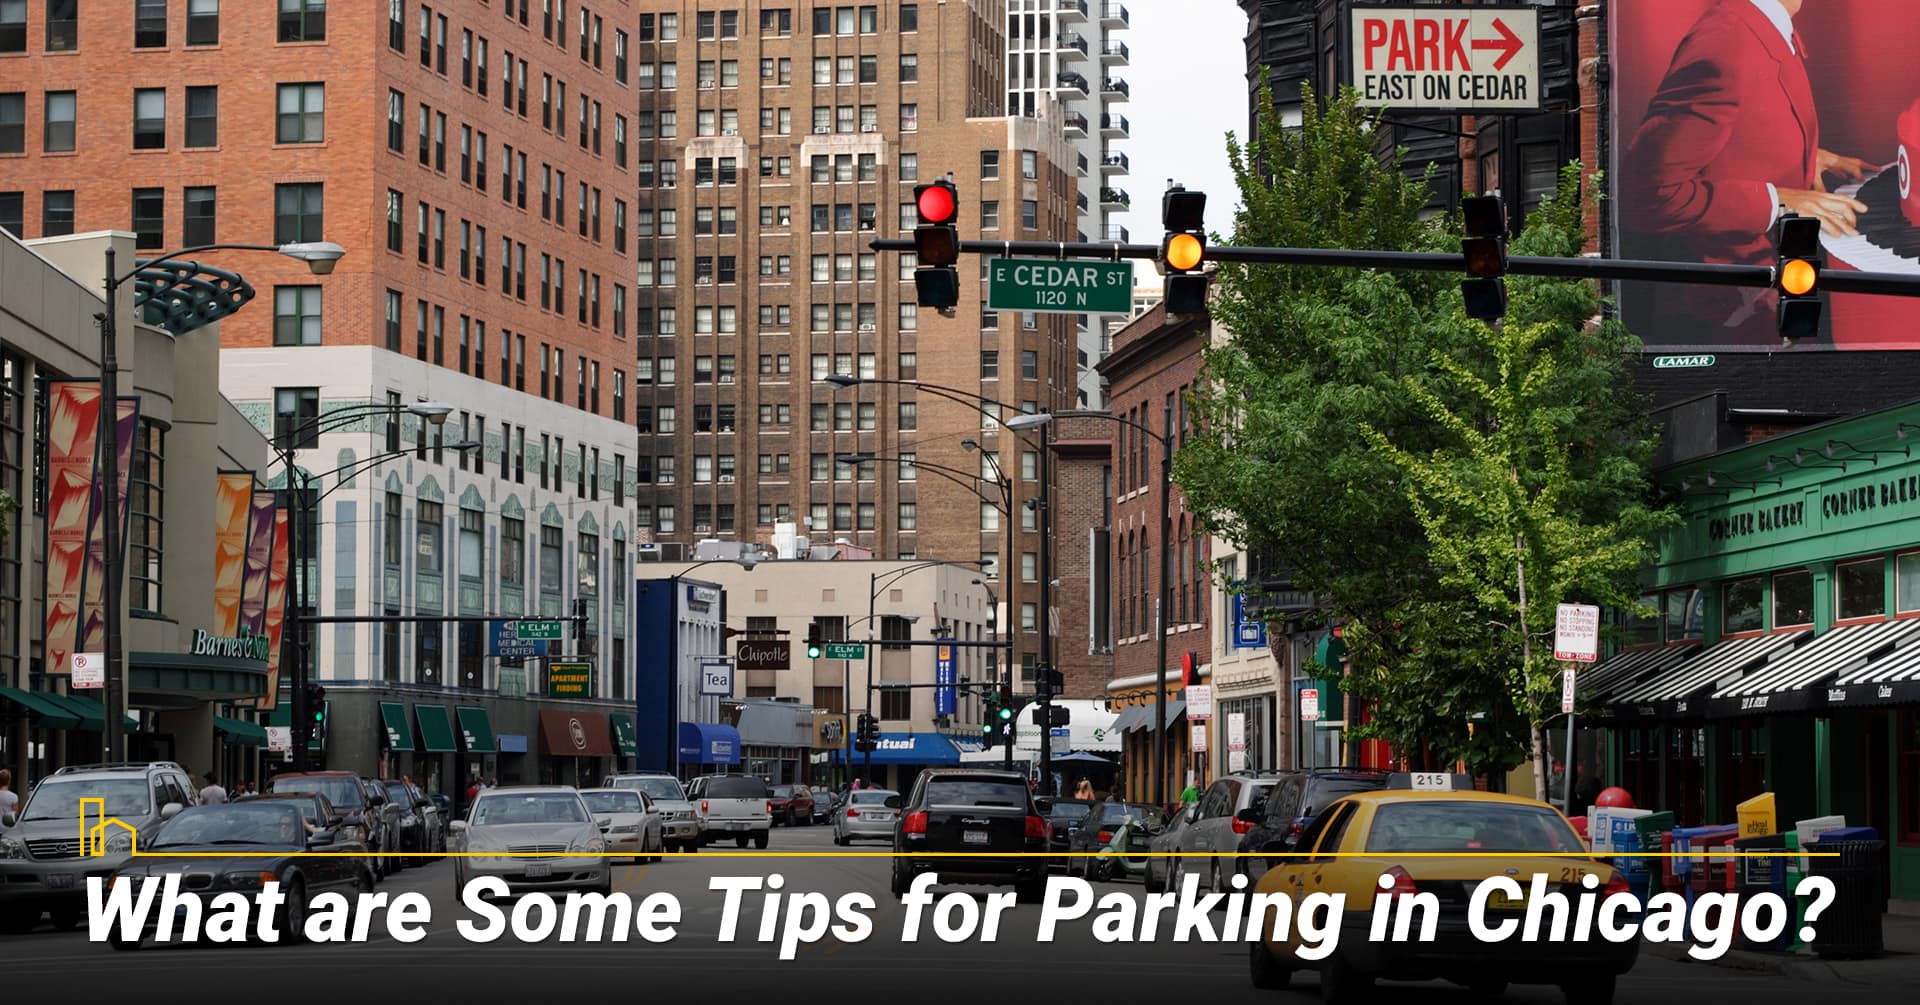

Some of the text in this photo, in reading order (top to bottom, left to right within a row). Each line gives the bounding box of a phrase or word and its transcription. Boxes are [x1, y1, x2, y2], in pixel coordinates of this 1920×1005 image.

[1363, 18, 1472, 72] PARK
[1365, 74, 1528, 101] EAST ON CEDAR
[996, 265, 1126, 288] E CEDAR ST
[1036, 290, 1087, 306] 1120 N
[1658, 356, 1709, 367] LAMAR
[1822, 474, 1920, 519] CORNER BAKE
[1709, 501, 1804, 541] CORNER BAKERY
[528, 623, 549, 631] ELM
[194, 628, 242, 657] Barnes
[498, 639, 536, 647] MEDICAL
[499, 647, 535, 655] CENTER
[738, 644, 788, 665] Chipotle
[551, 674, 588, 682] APARTMENT
[705, 672, 728, 686] Tea
[876, 738, 915, 750] tual
[1416, 774, 1443, 785] 215
[1560, 867, 1585, 883] 215
